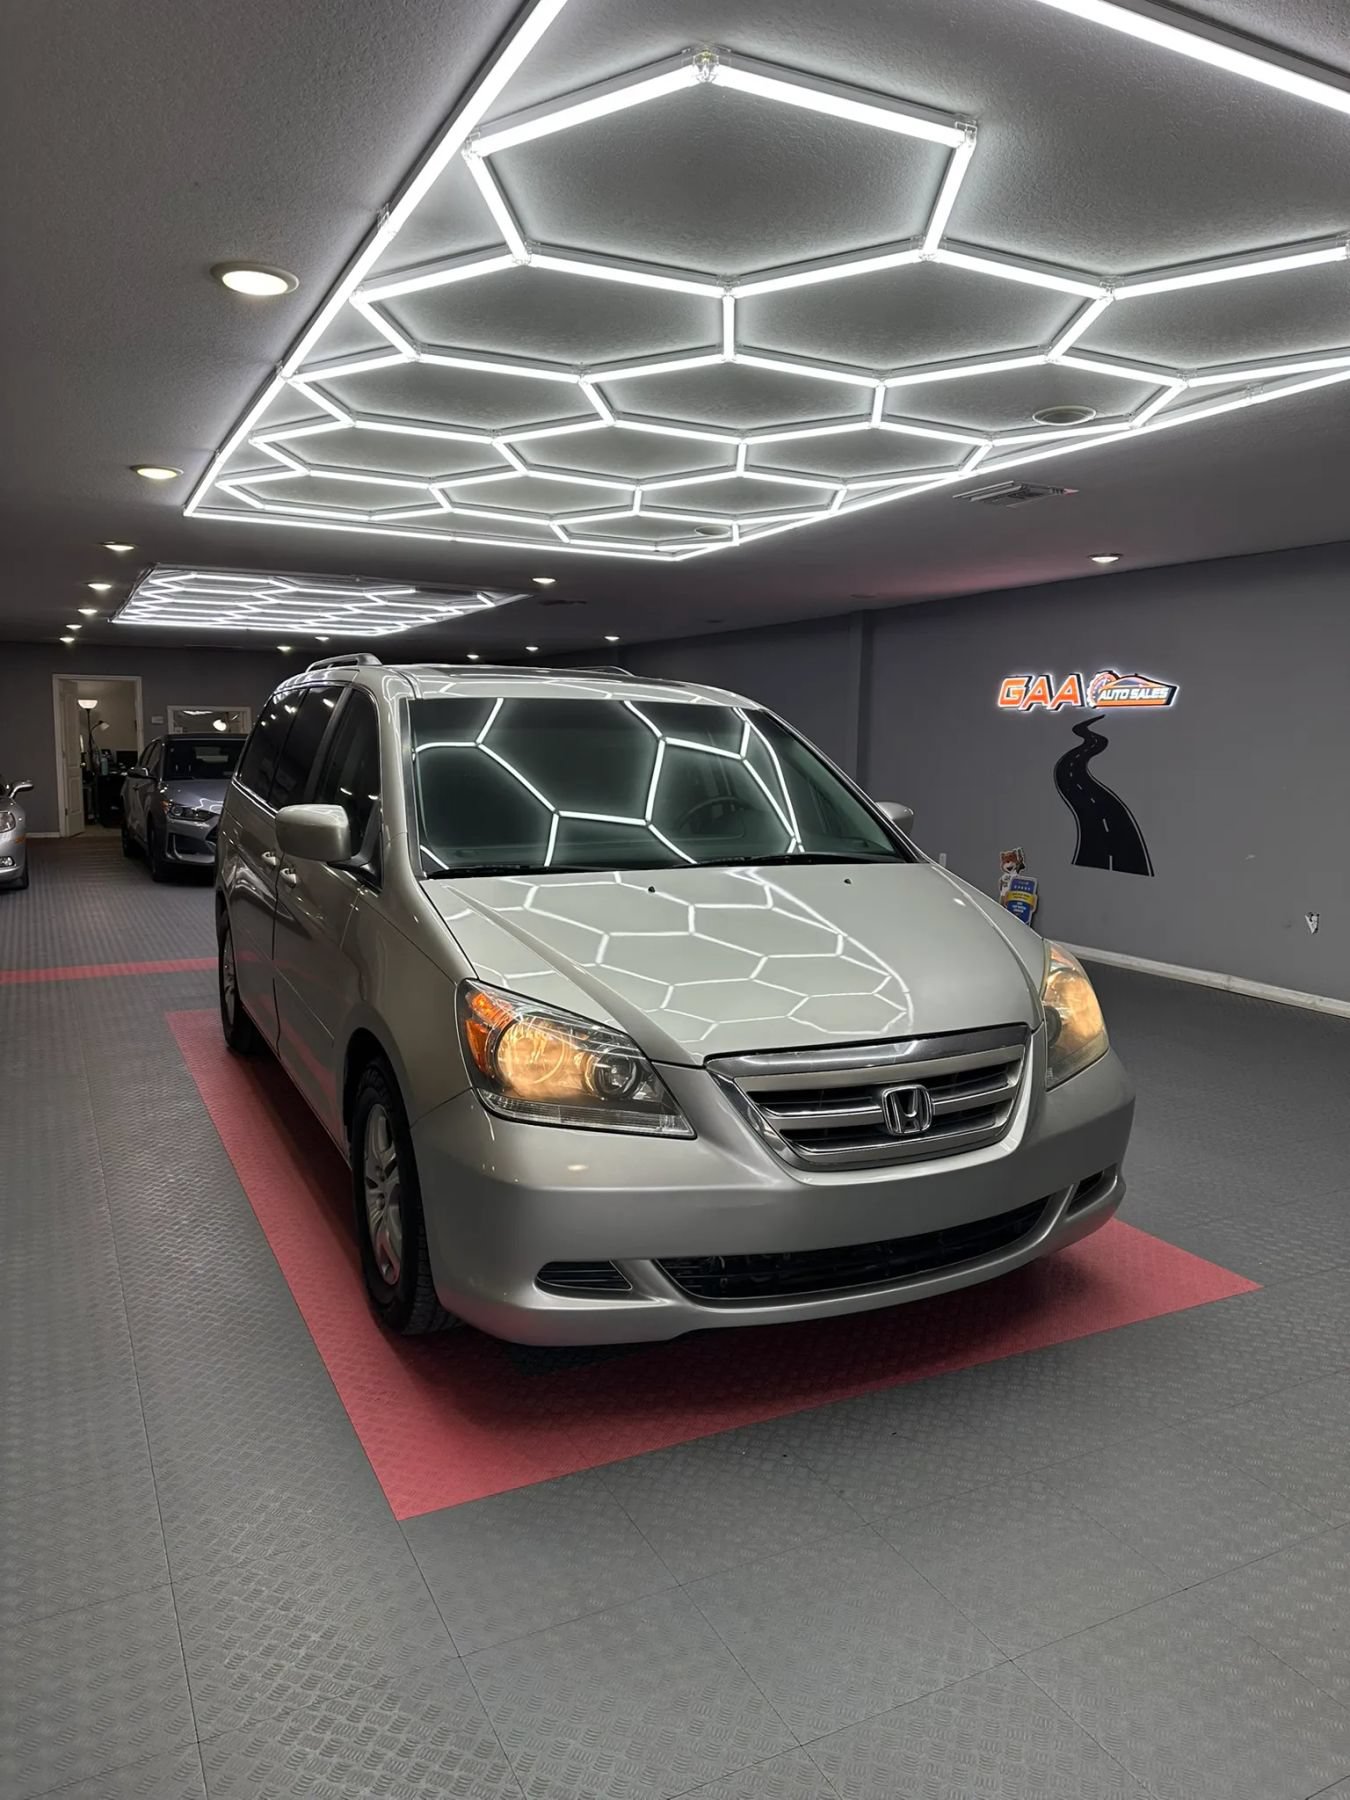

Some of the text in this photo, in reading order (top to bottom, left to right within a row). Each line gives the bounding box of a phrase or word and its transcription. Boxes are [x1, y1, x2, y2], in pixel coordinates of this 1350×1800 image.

[999, 674, 1083, 710] GAA
[1100, 688, 1168, 700] AUTO SALES
